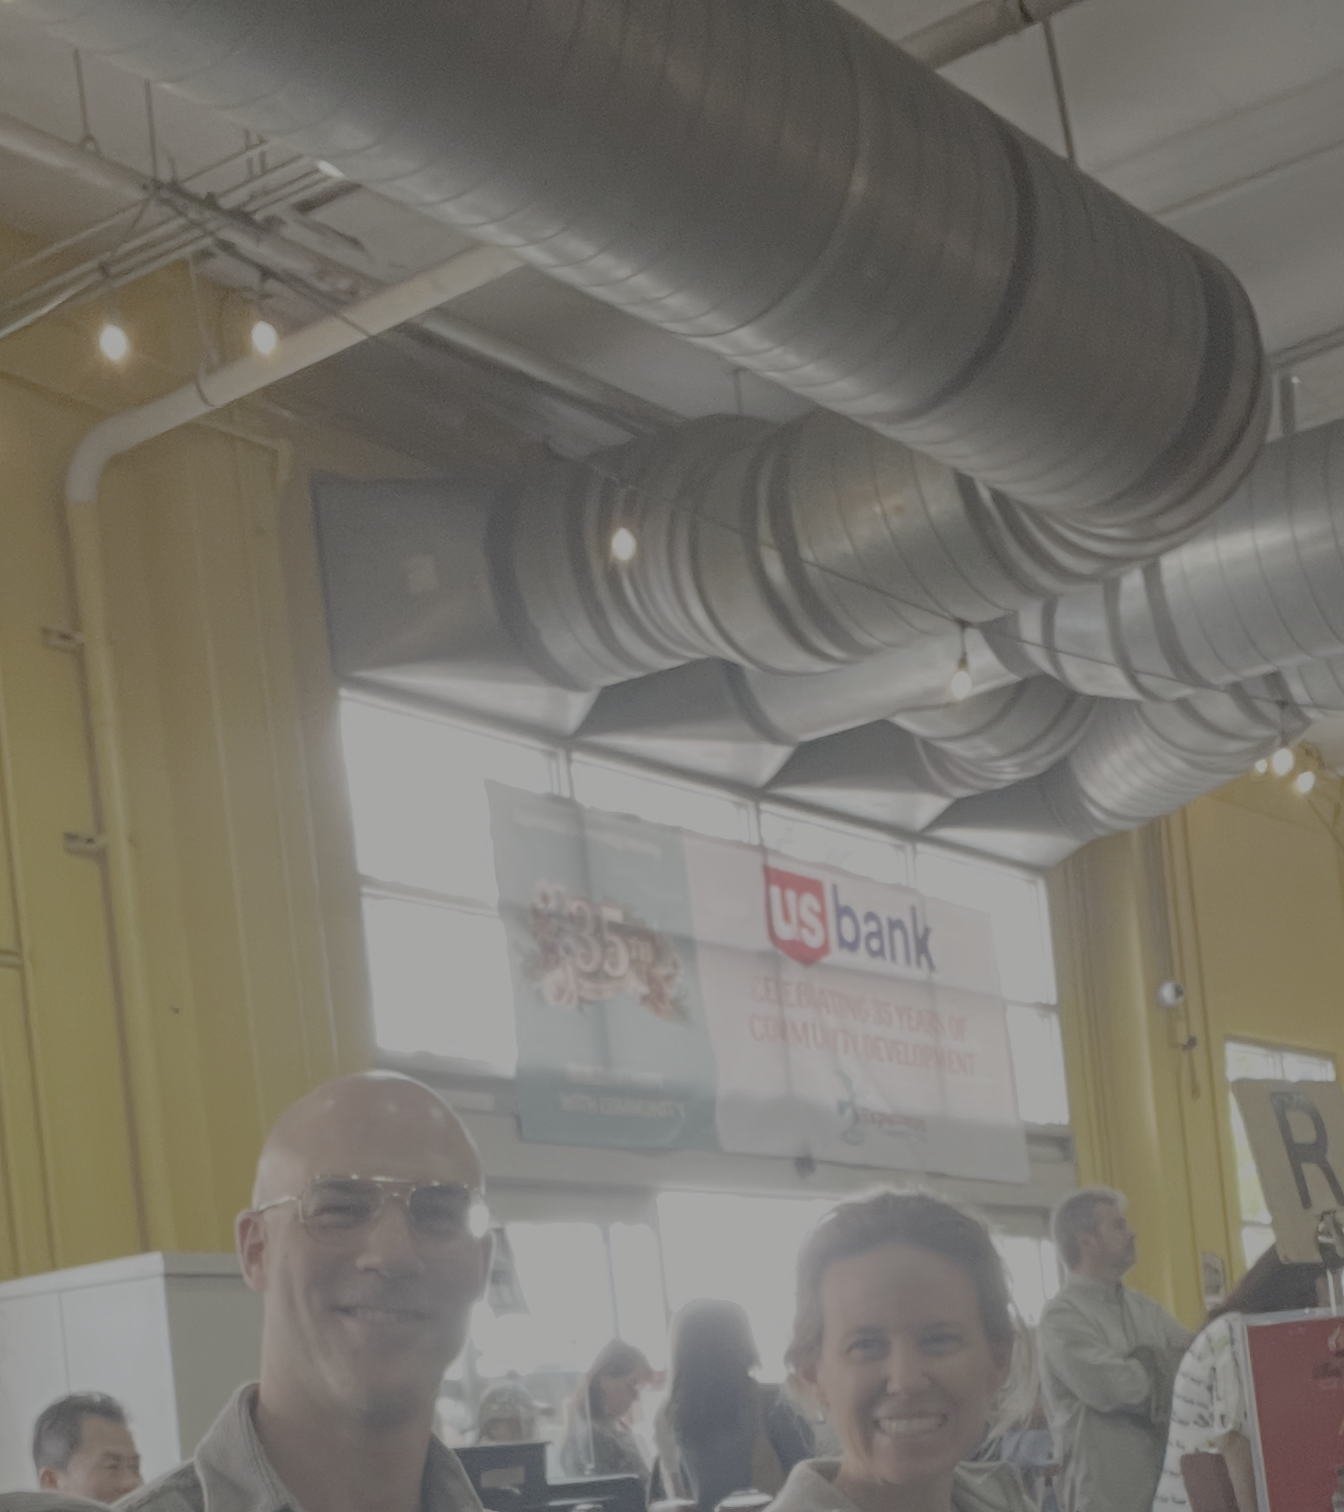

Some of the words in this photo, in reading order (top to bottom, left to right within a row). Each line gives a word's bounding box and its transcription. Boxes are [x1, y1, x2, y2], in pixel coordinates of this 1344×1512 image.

[769, 884, 826, 950] us
[831, 882, 937, 973] bank
[751, 974, 869, 1022] CELEBRATING
[947, 1014, 968, 1041] OF
